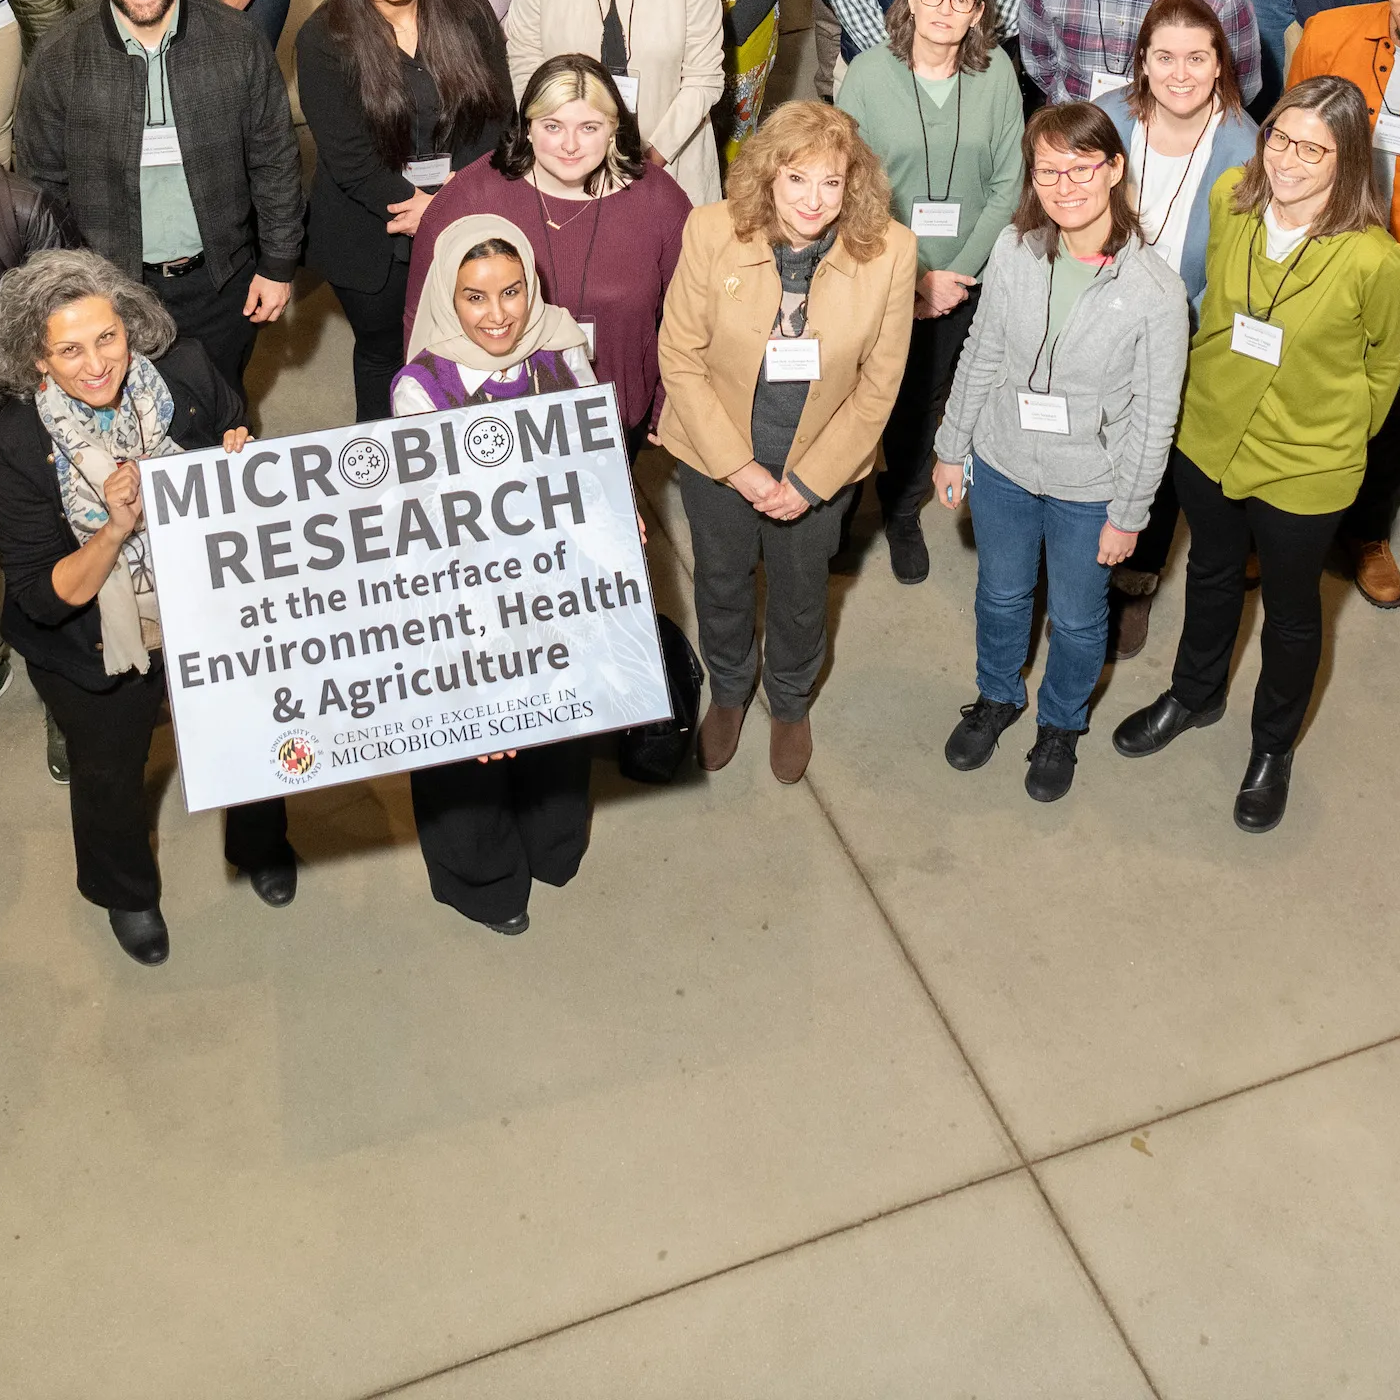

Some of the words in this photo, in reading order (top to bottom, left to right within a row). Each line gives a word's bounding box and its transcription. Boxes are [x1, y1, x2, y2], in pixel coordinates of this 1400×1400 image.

[151, 396, 616, 526] MICROBIOME
[205, 471, 586, 590] RESEARCH
[239, 597, 277, 628] at
[285, 586, 347, 619] the
[357, 559, 522, 607] Interface
[533, 540, 566, 574] of
[178, 603, 486, 689] Environment,
[497, 571, 642, 629] Health
[272, 686, 306, 723] &
[318, 642, 570, 719] Agriculture
[333, 722, 404, 745] CENTER
[411, 716, 434, 730] OF
[441, 693, 552, 725] EXCELLENCE
[558, 687, 577, 702] IN
[271, 728, 310, 753] UNIVERSITY
[310, 735, 319, 744] OF
[274, 762, 322, 785] MARYLAND
[331, 722, 483, 768] MICROBIOME
[489, 700, 594, 736] SCIENCES
